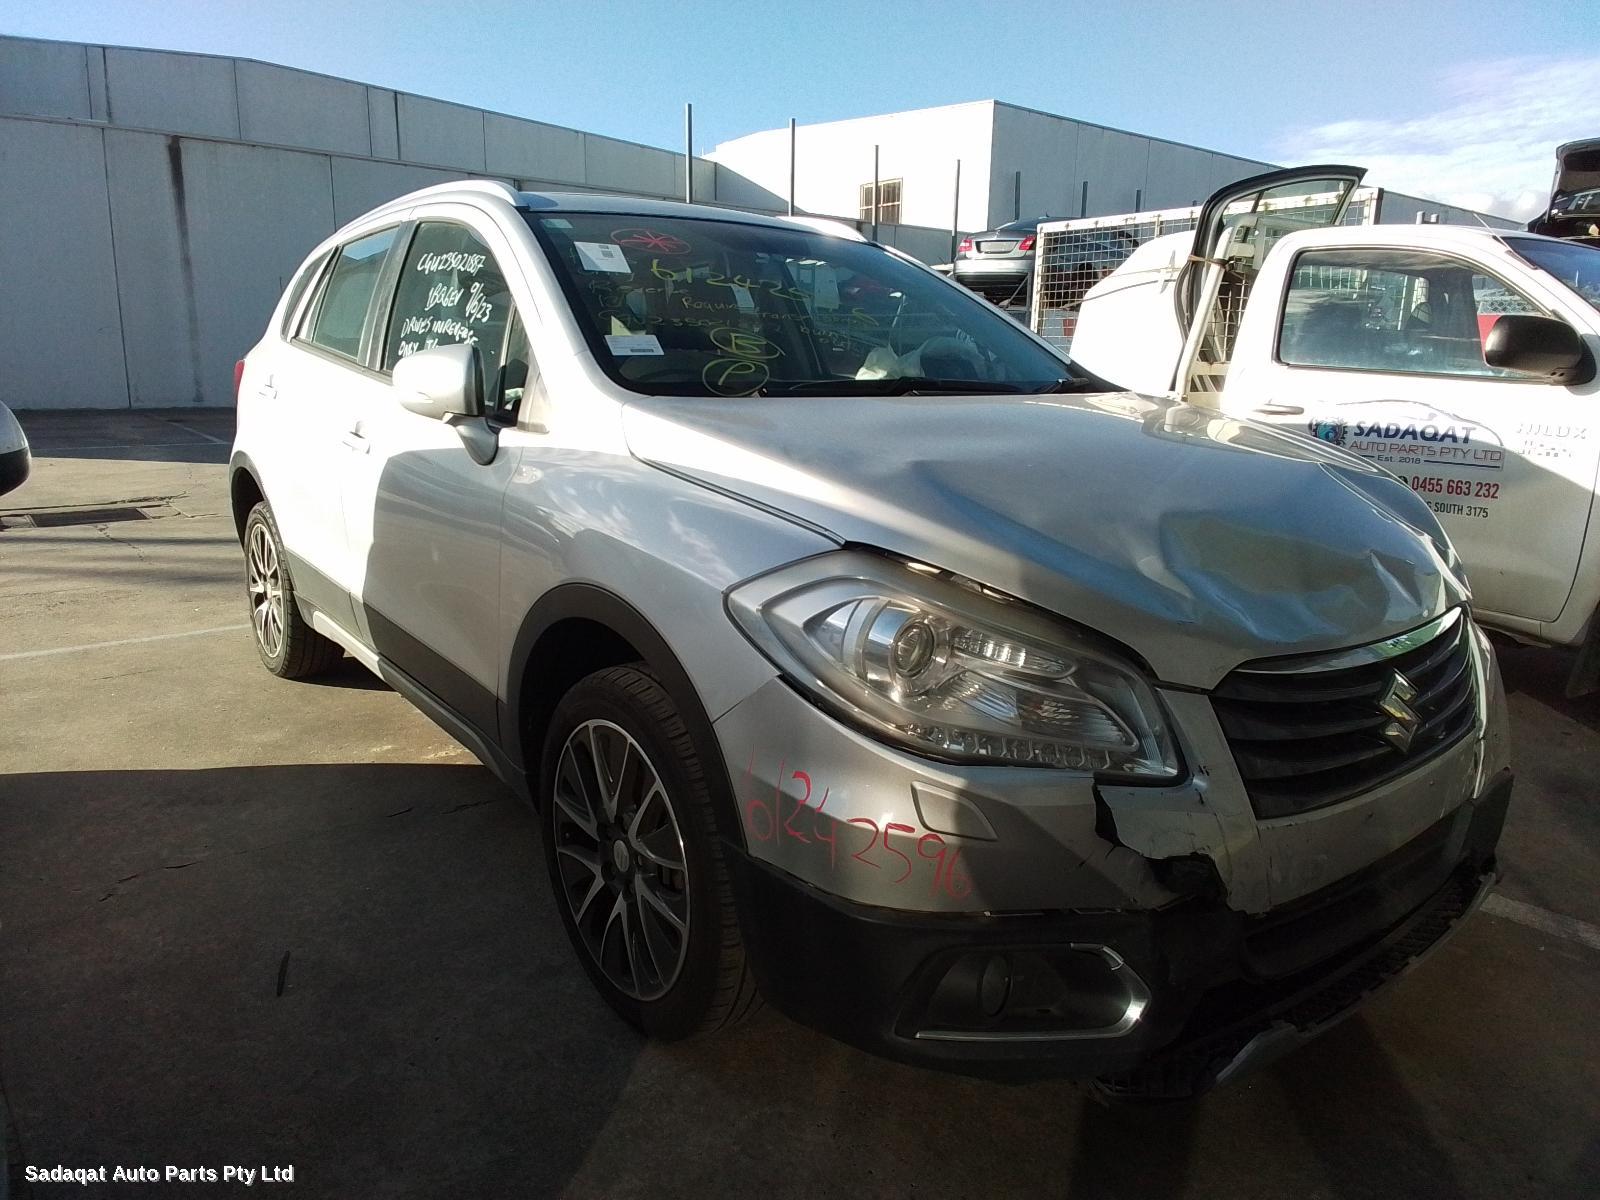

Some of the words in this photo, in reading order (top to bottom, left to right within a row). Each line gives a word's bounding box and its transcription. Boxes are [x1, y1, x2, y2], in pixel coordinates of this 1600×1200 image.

[1354, 421, 1476, 444] SADAQAT
[1350, 441, 1387, 453] AUTO
[1390, 443, 1436, 457] PARTS
[1439, 447, 1471, 458] PTY
[1473, 450, 1502, 461] LTD
[1399, 456, 1421, 465] 2018
[1411, 476, 1443, 493] 0455
[1446, 479, 1471, 496] 663
[1474, 482, 1500, 499] 232
[1433, 502, 1464, 515] SOUTH
[1465, 505, 1489, 518] 3175
